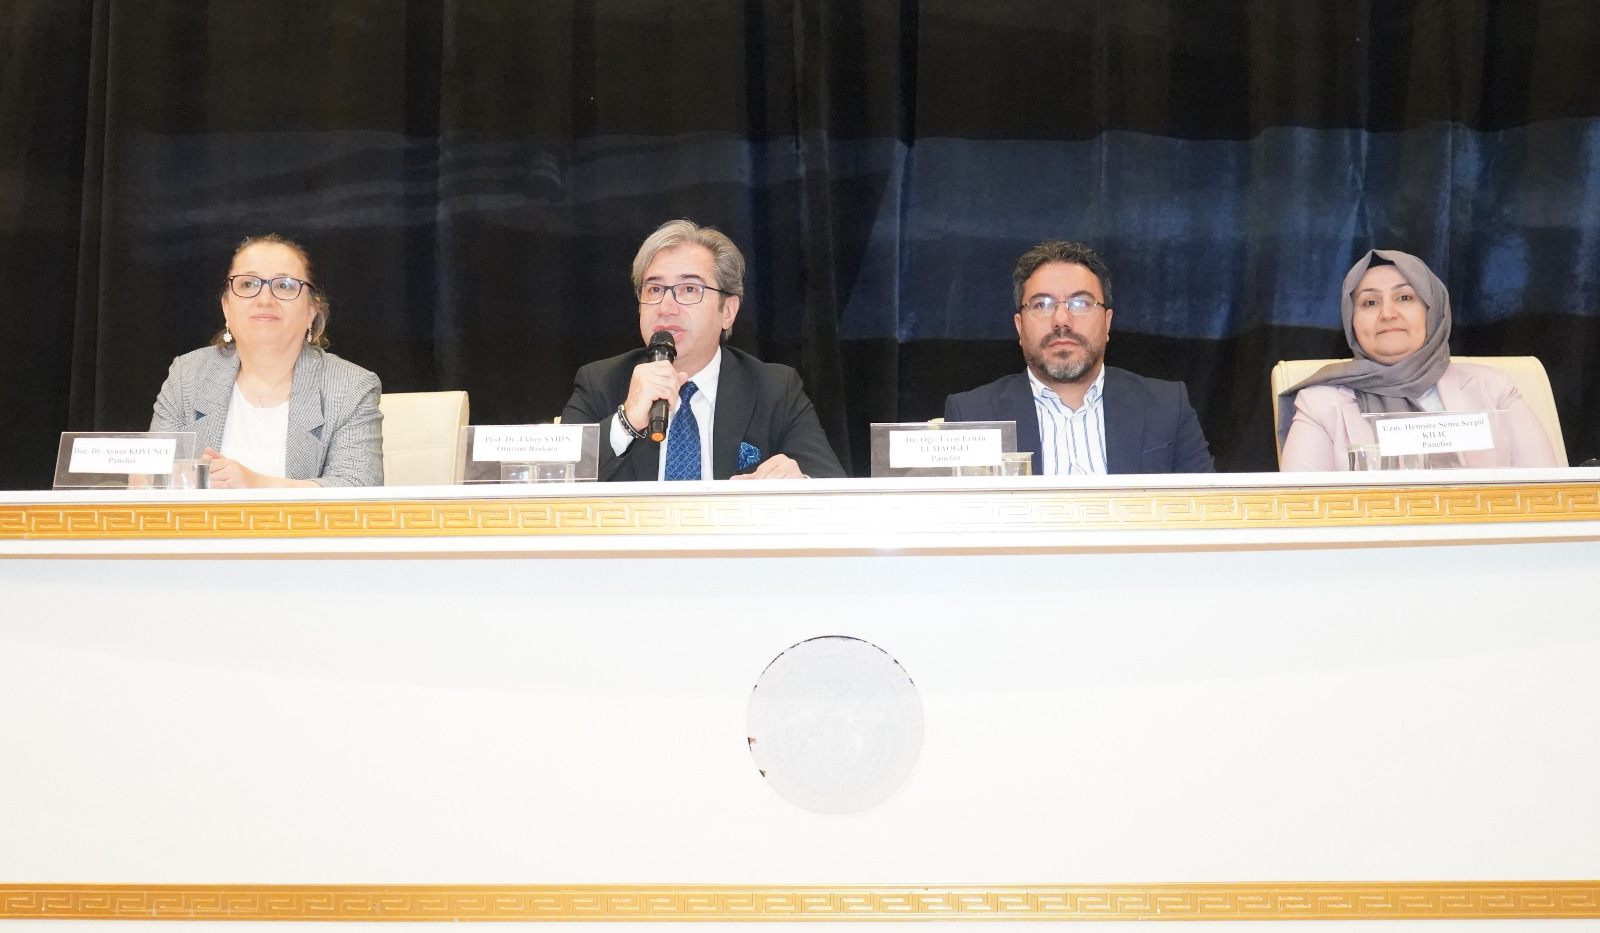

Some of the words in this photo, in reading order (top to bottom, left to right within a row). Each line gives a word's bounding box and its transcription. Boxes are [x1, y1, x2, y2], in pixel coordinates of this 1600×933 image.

[1461, 418, 1485, 428] Serpil
[1422, 440, 1453, 448] Panelist
[931, 454, 961, 462] Panelist
